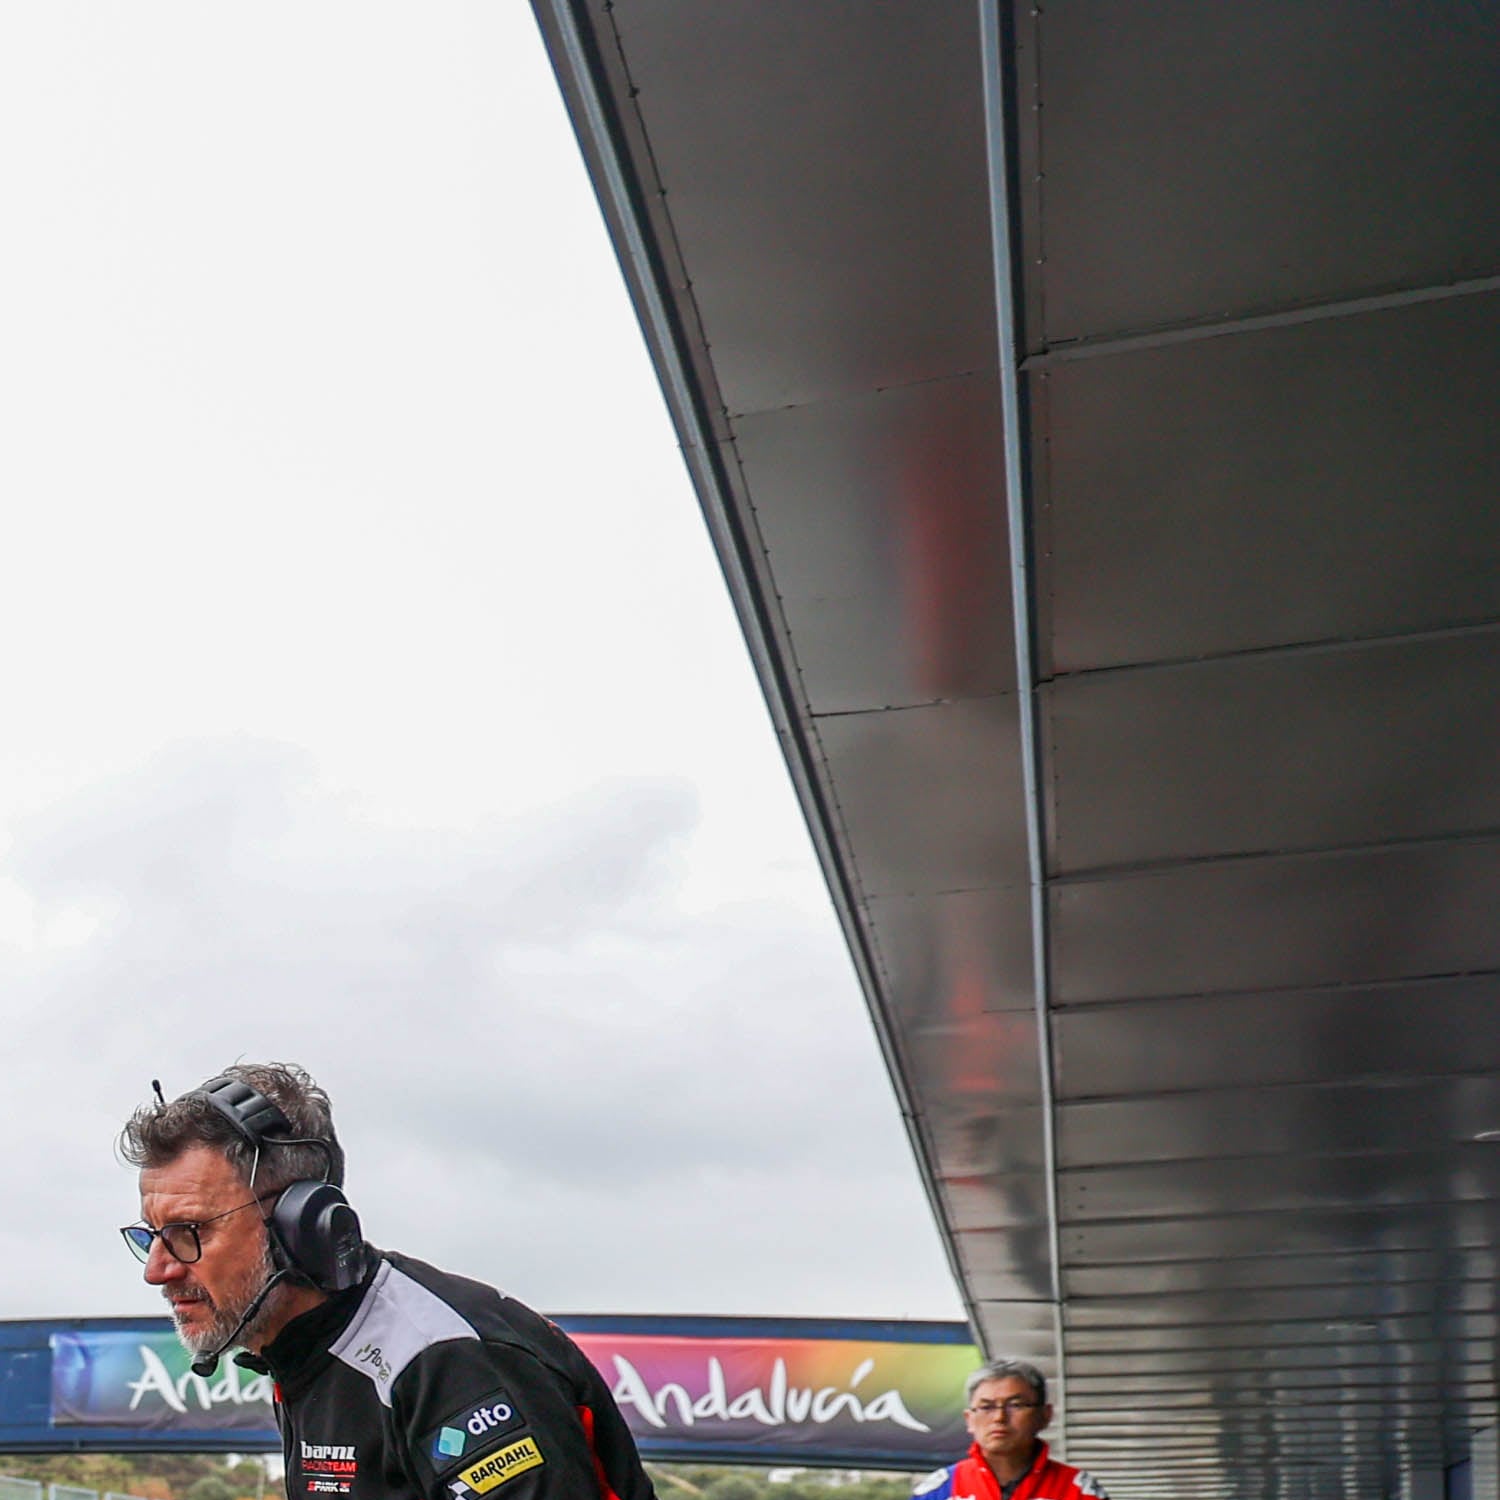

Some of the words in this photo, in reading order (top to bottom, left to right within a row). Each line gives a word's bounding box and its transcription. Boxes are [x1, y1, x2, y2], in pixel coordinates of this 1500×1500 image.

[612, 1354, 932, 1433] Andalucía
[467, 1403, 512, 1436] dto
[470, 1444, 535, 1484] BARDAHL
